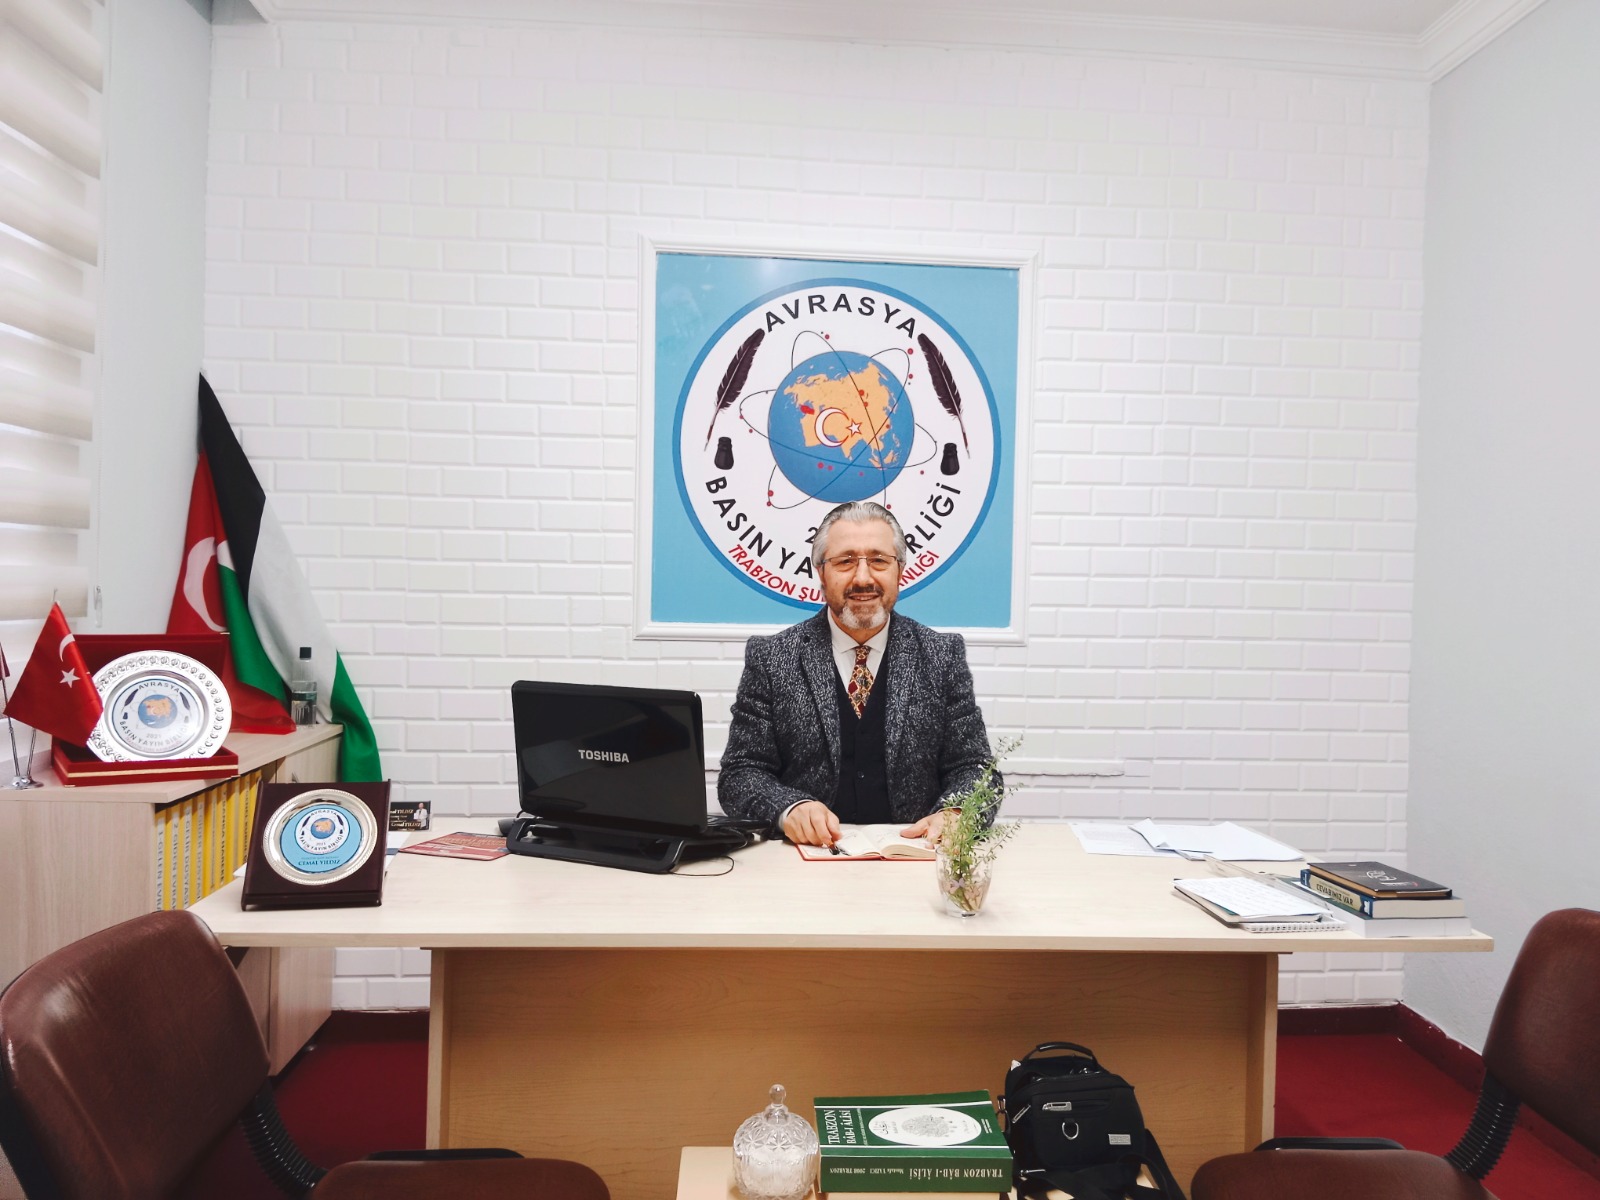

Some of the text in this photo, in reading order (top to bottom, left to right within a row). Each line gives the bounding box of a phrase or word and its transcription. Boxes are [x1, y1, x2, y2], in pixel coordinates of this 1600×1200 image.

[765, 293, 916, 339] AVRASYA
[705, 476, 961, 558] BASIN RLİĞİ
[728, 544, 797, 596] TRABZON
[798, 586, 825, 603] ŞU
[138, 681, 180, 693] AVRASYA
[120, 720, 137, 740] BASIN
[578, 749, 630, 763] TOSHIBA
[823, 1109, 840, 1145] TRABZON
[963, 1168, 1003, 1178] TRABZON
